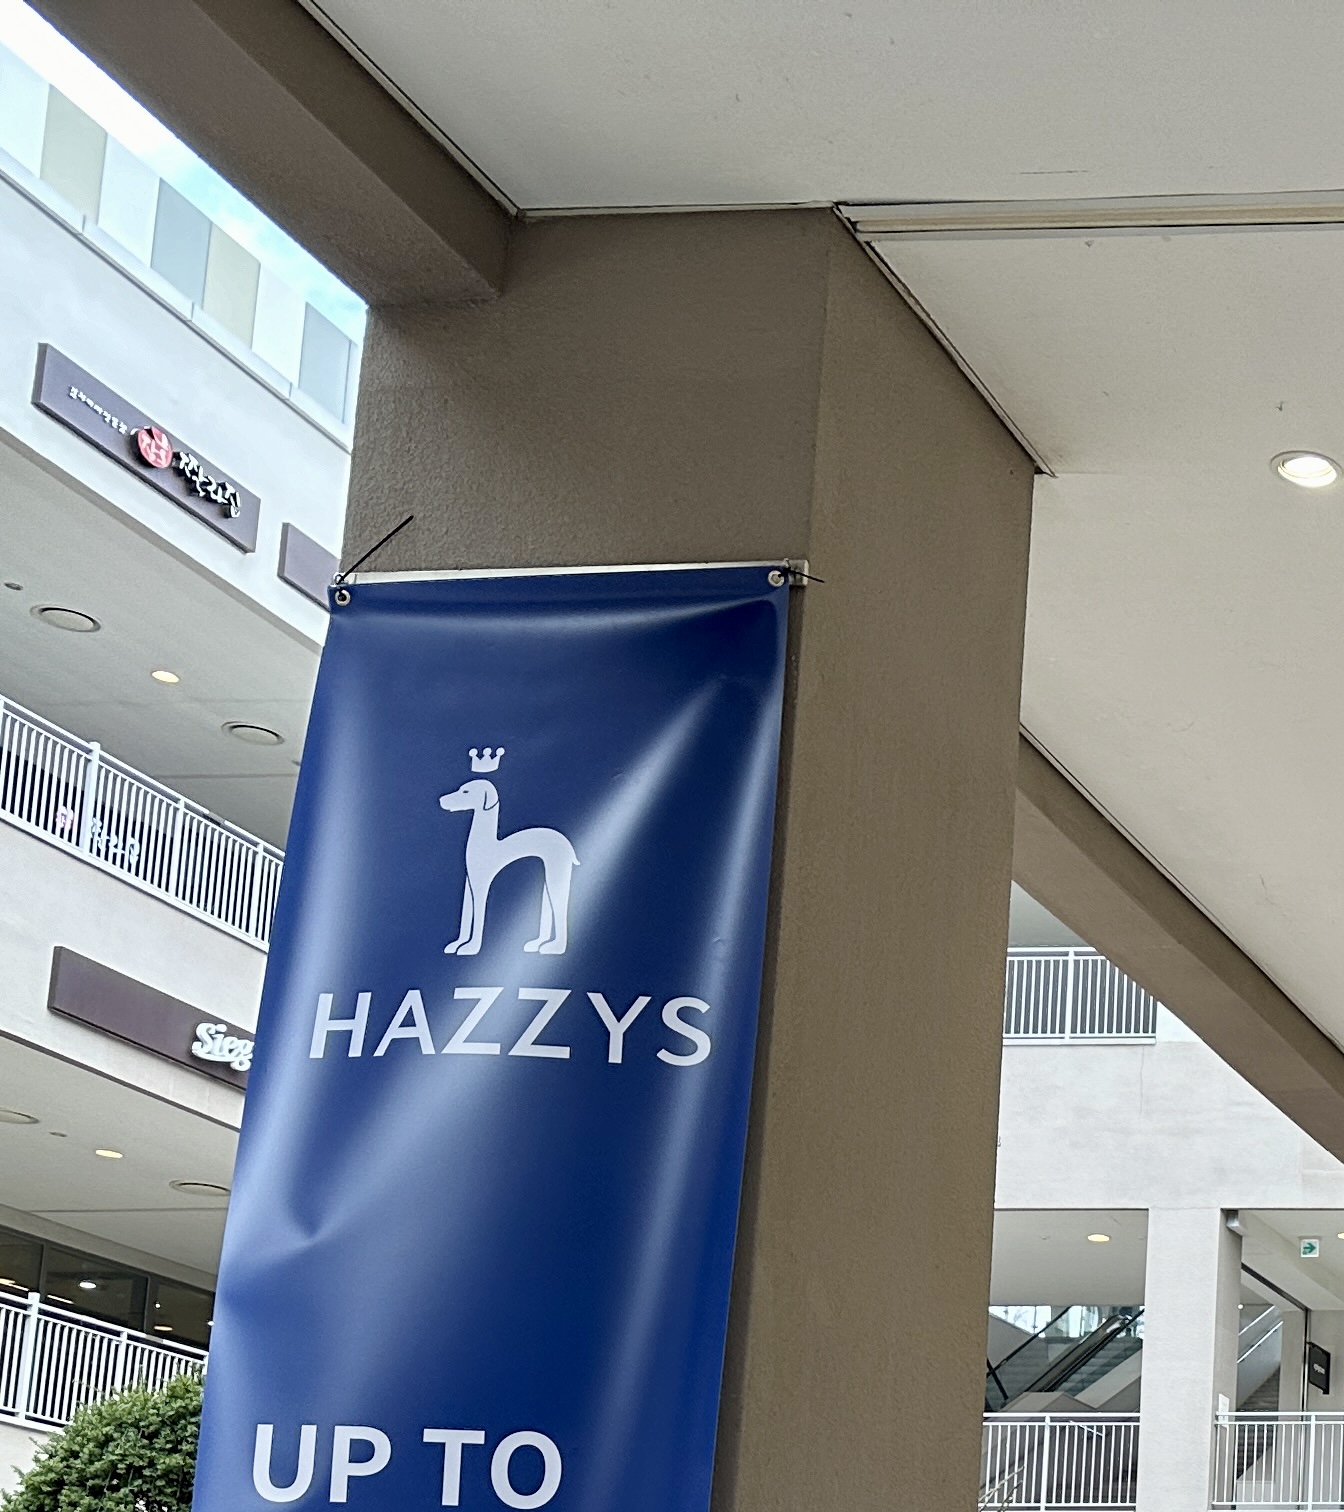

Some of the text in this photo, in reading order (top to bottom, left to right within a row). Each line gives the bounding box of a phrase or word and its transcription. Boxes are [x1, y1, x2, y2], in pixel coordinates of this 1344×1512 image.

[192, 1023, 254, 1071] Sieg
[309, 987, 711, 1066] HAZZYS
[252, 1424, 562, 1510] UP TO
